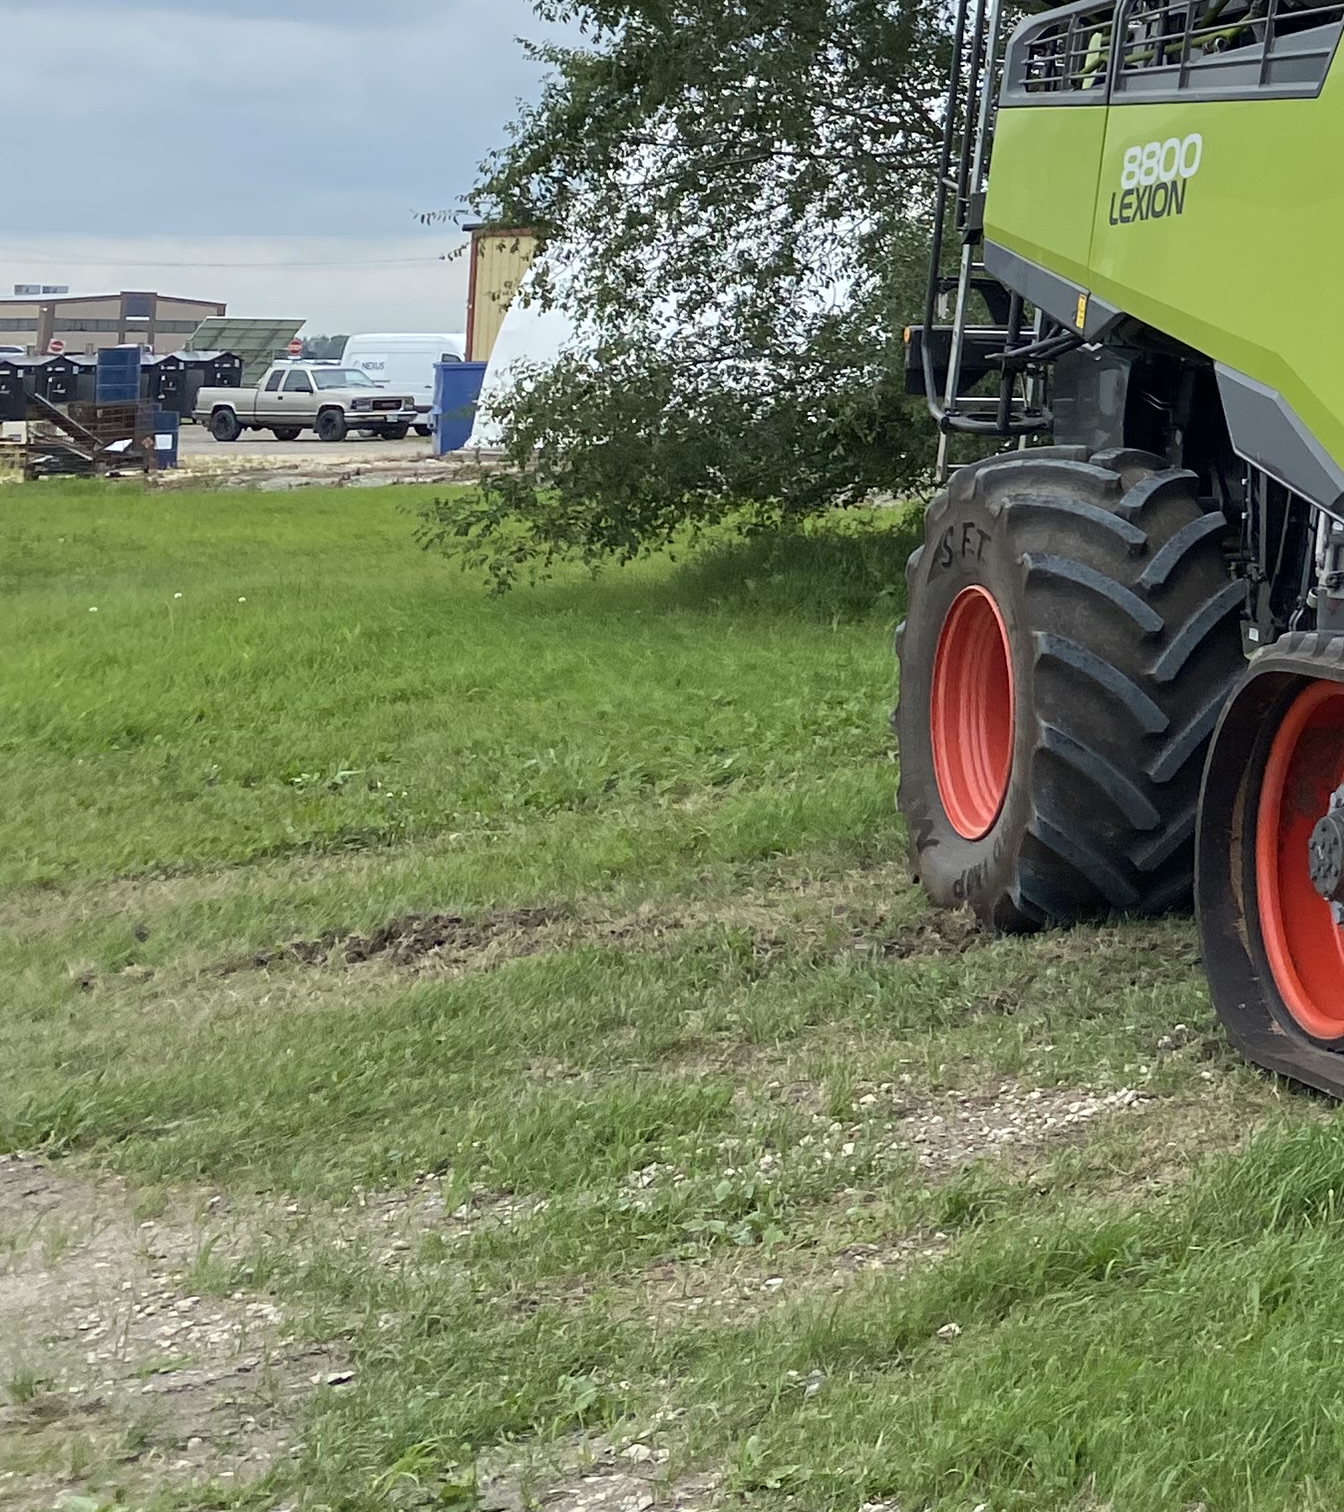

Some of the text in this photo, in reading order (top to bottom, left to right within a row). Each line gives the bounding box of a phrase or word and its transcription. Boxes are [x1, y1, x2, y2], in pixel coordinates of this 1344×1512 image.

[1121, 133, 1203, 190] 8800
[1109, 178, 1187, 225] LEXION
[361, 361, 385, 369] NEXUS
